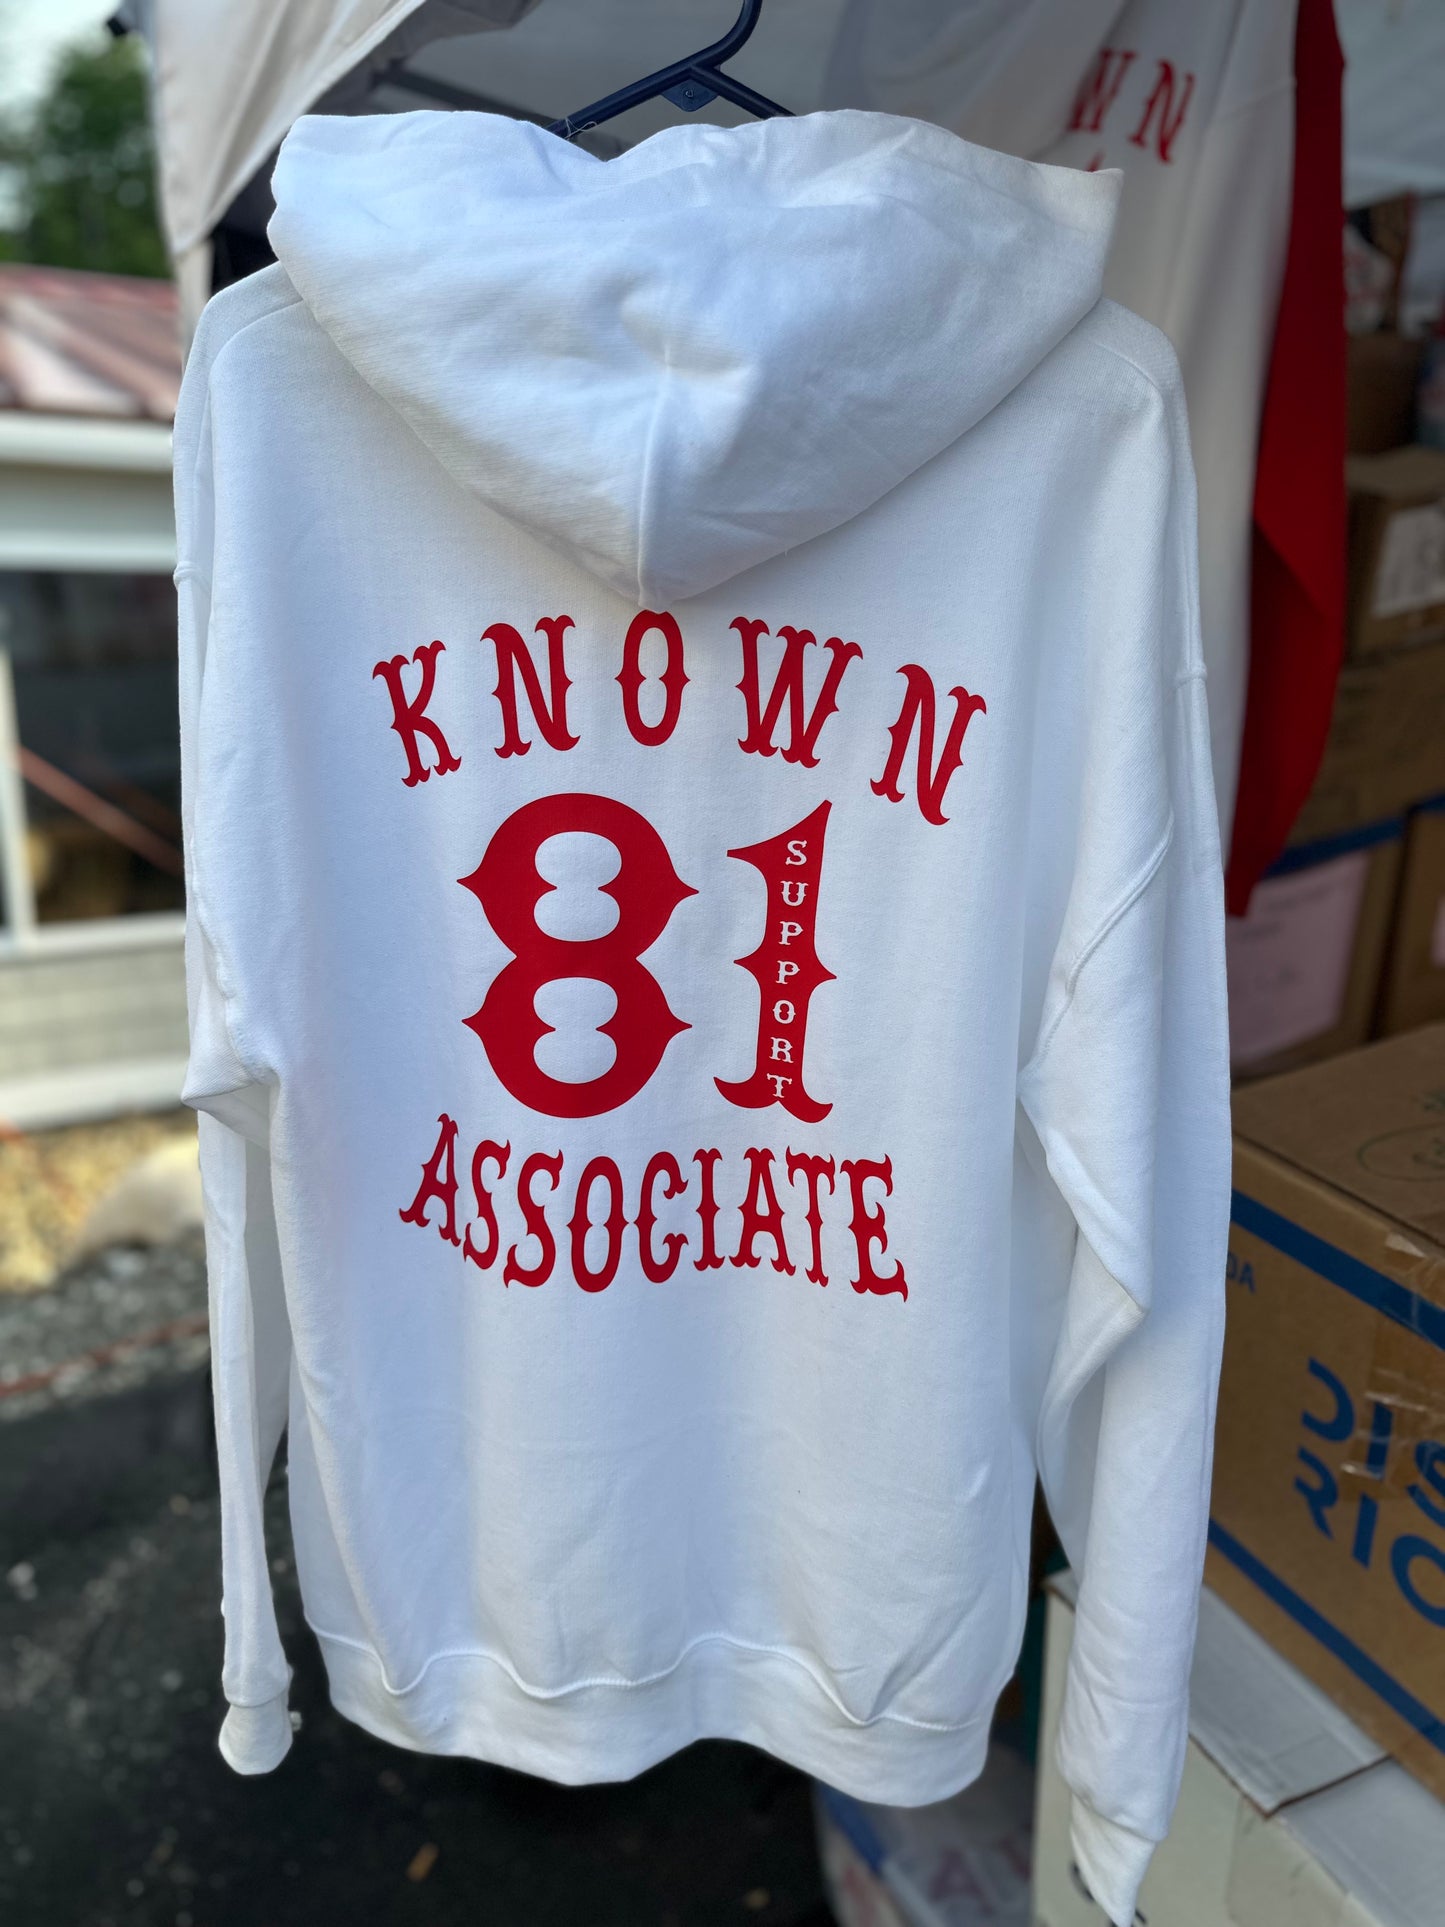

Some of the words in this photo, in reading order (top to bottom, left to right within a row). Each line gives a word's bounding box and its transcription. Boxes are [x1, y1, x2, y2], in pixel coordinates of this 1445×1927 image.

[372, 609, 987, 826] KNOWN
[456, 792, 837, 1124] 81
[766, 839, 809, 1099] SUPPORT
[398, 1113, 909, 1302] ASSOCIATE
